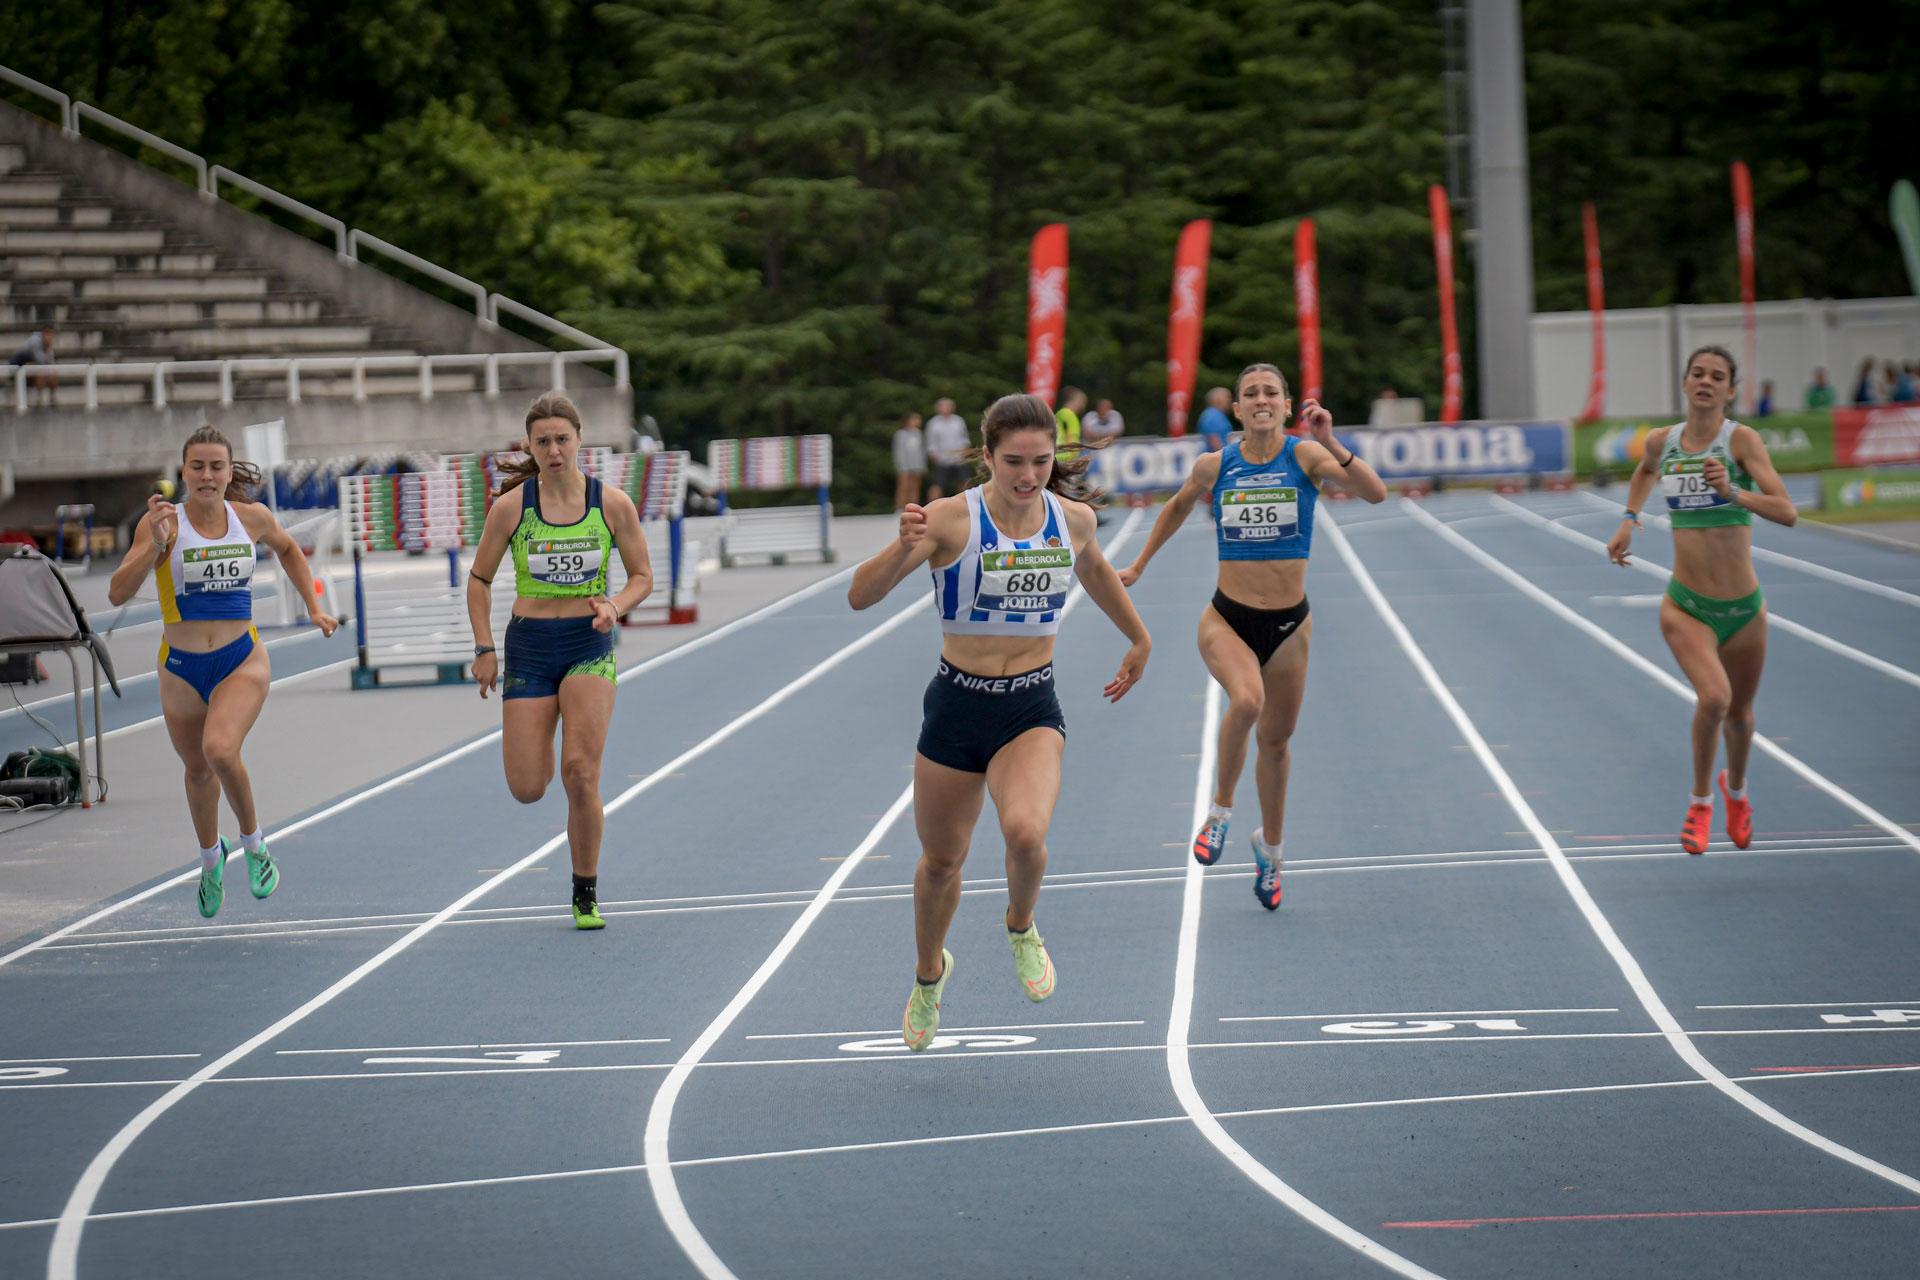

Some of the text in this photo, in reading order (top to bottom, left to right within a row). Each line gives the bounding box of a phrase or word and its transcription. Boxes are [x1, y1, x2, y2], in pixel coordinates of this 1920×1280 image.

[1677, 476, 1710, 493] 703
[1239, 506, 1278, 524] 436
[552, 541, 592, 551] IBERDROLA
[547, 554, 584, 572] 559
[1015, 554, 1062, 565] IBERDROLA
[203, 560, 240, 578] 416
[1006, 572, 1051, 593] 680
[953, 666, 1053, 692] NIKE PRO
